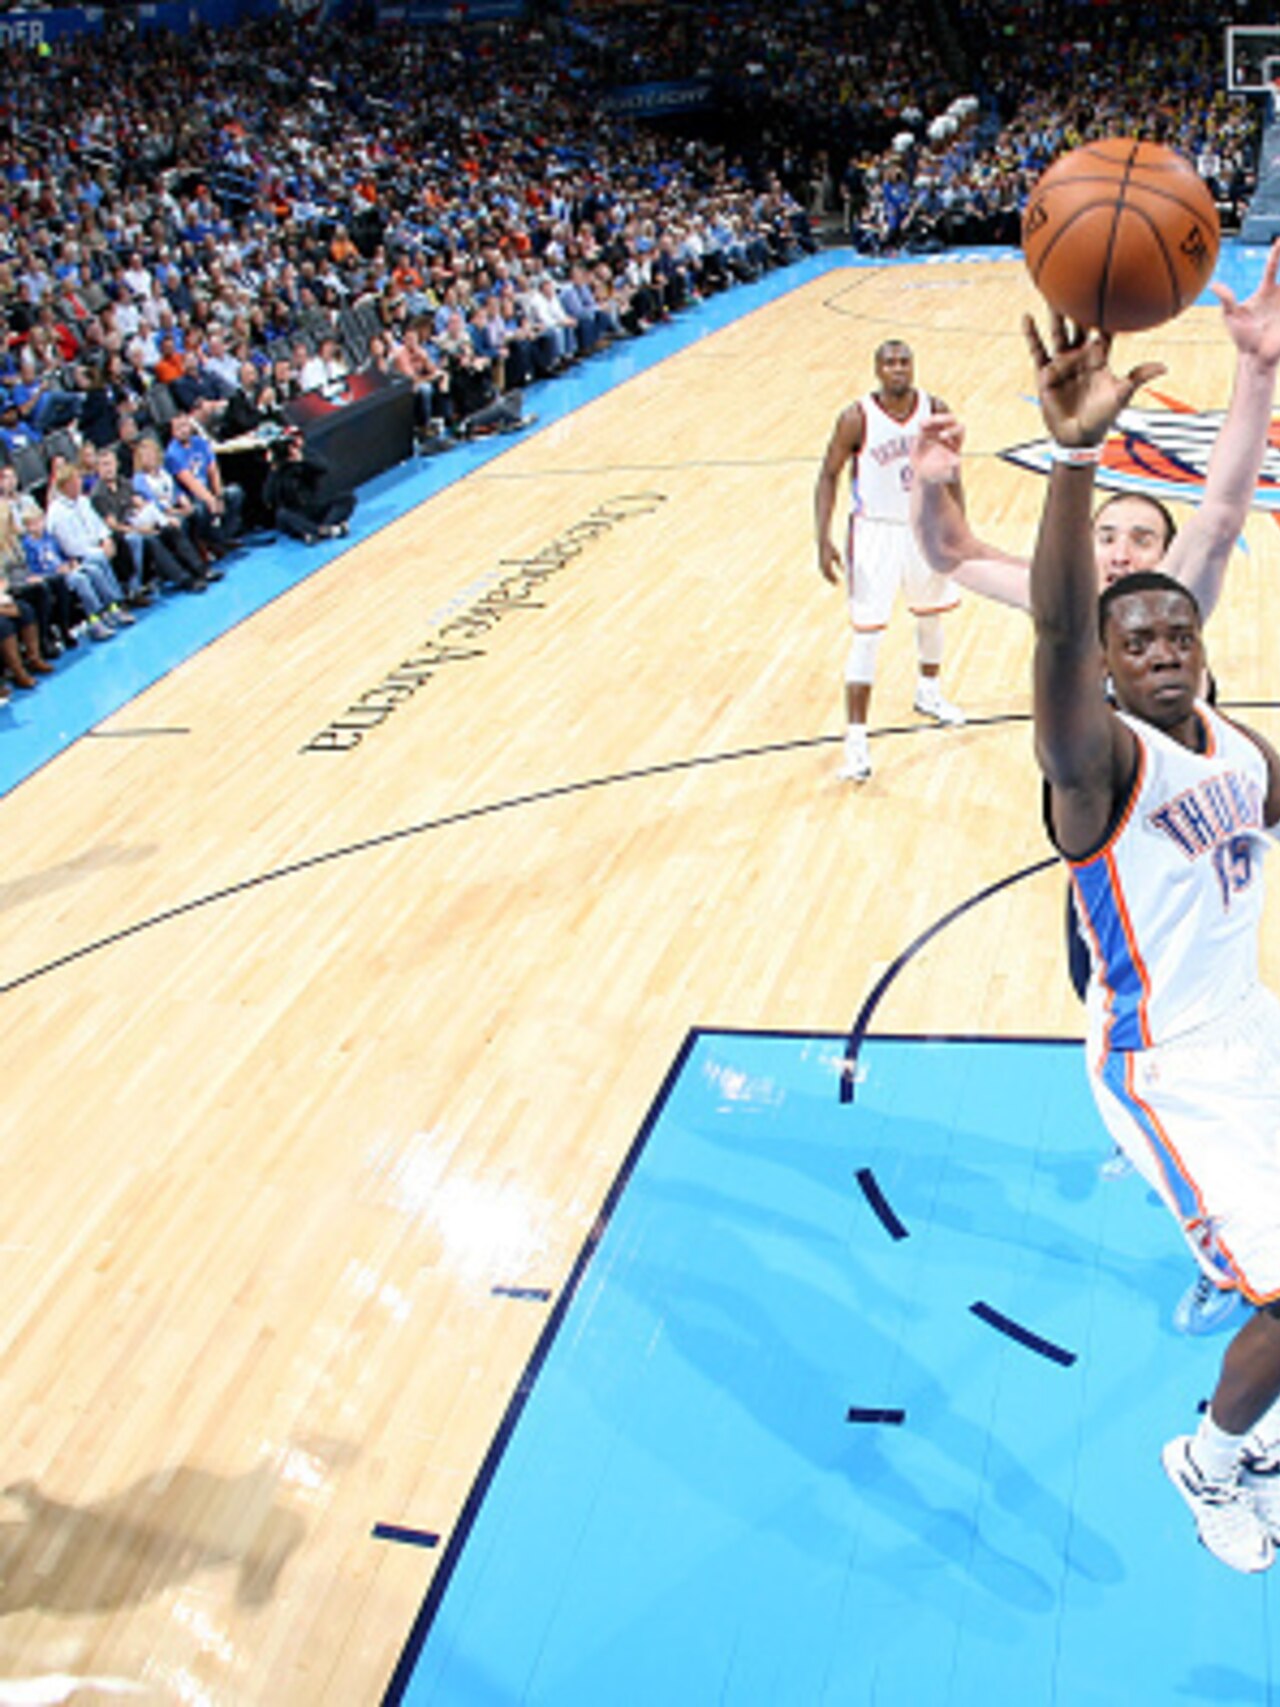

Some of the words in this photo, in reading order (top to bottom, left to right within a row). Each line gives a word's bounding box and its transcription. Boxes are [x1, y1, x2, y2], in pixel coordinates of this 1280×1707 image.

[439, 491, 668, 641] Chesapeake
[297, 640, 488, 754] Arena
[1211, 833, 1255, 914] 15
